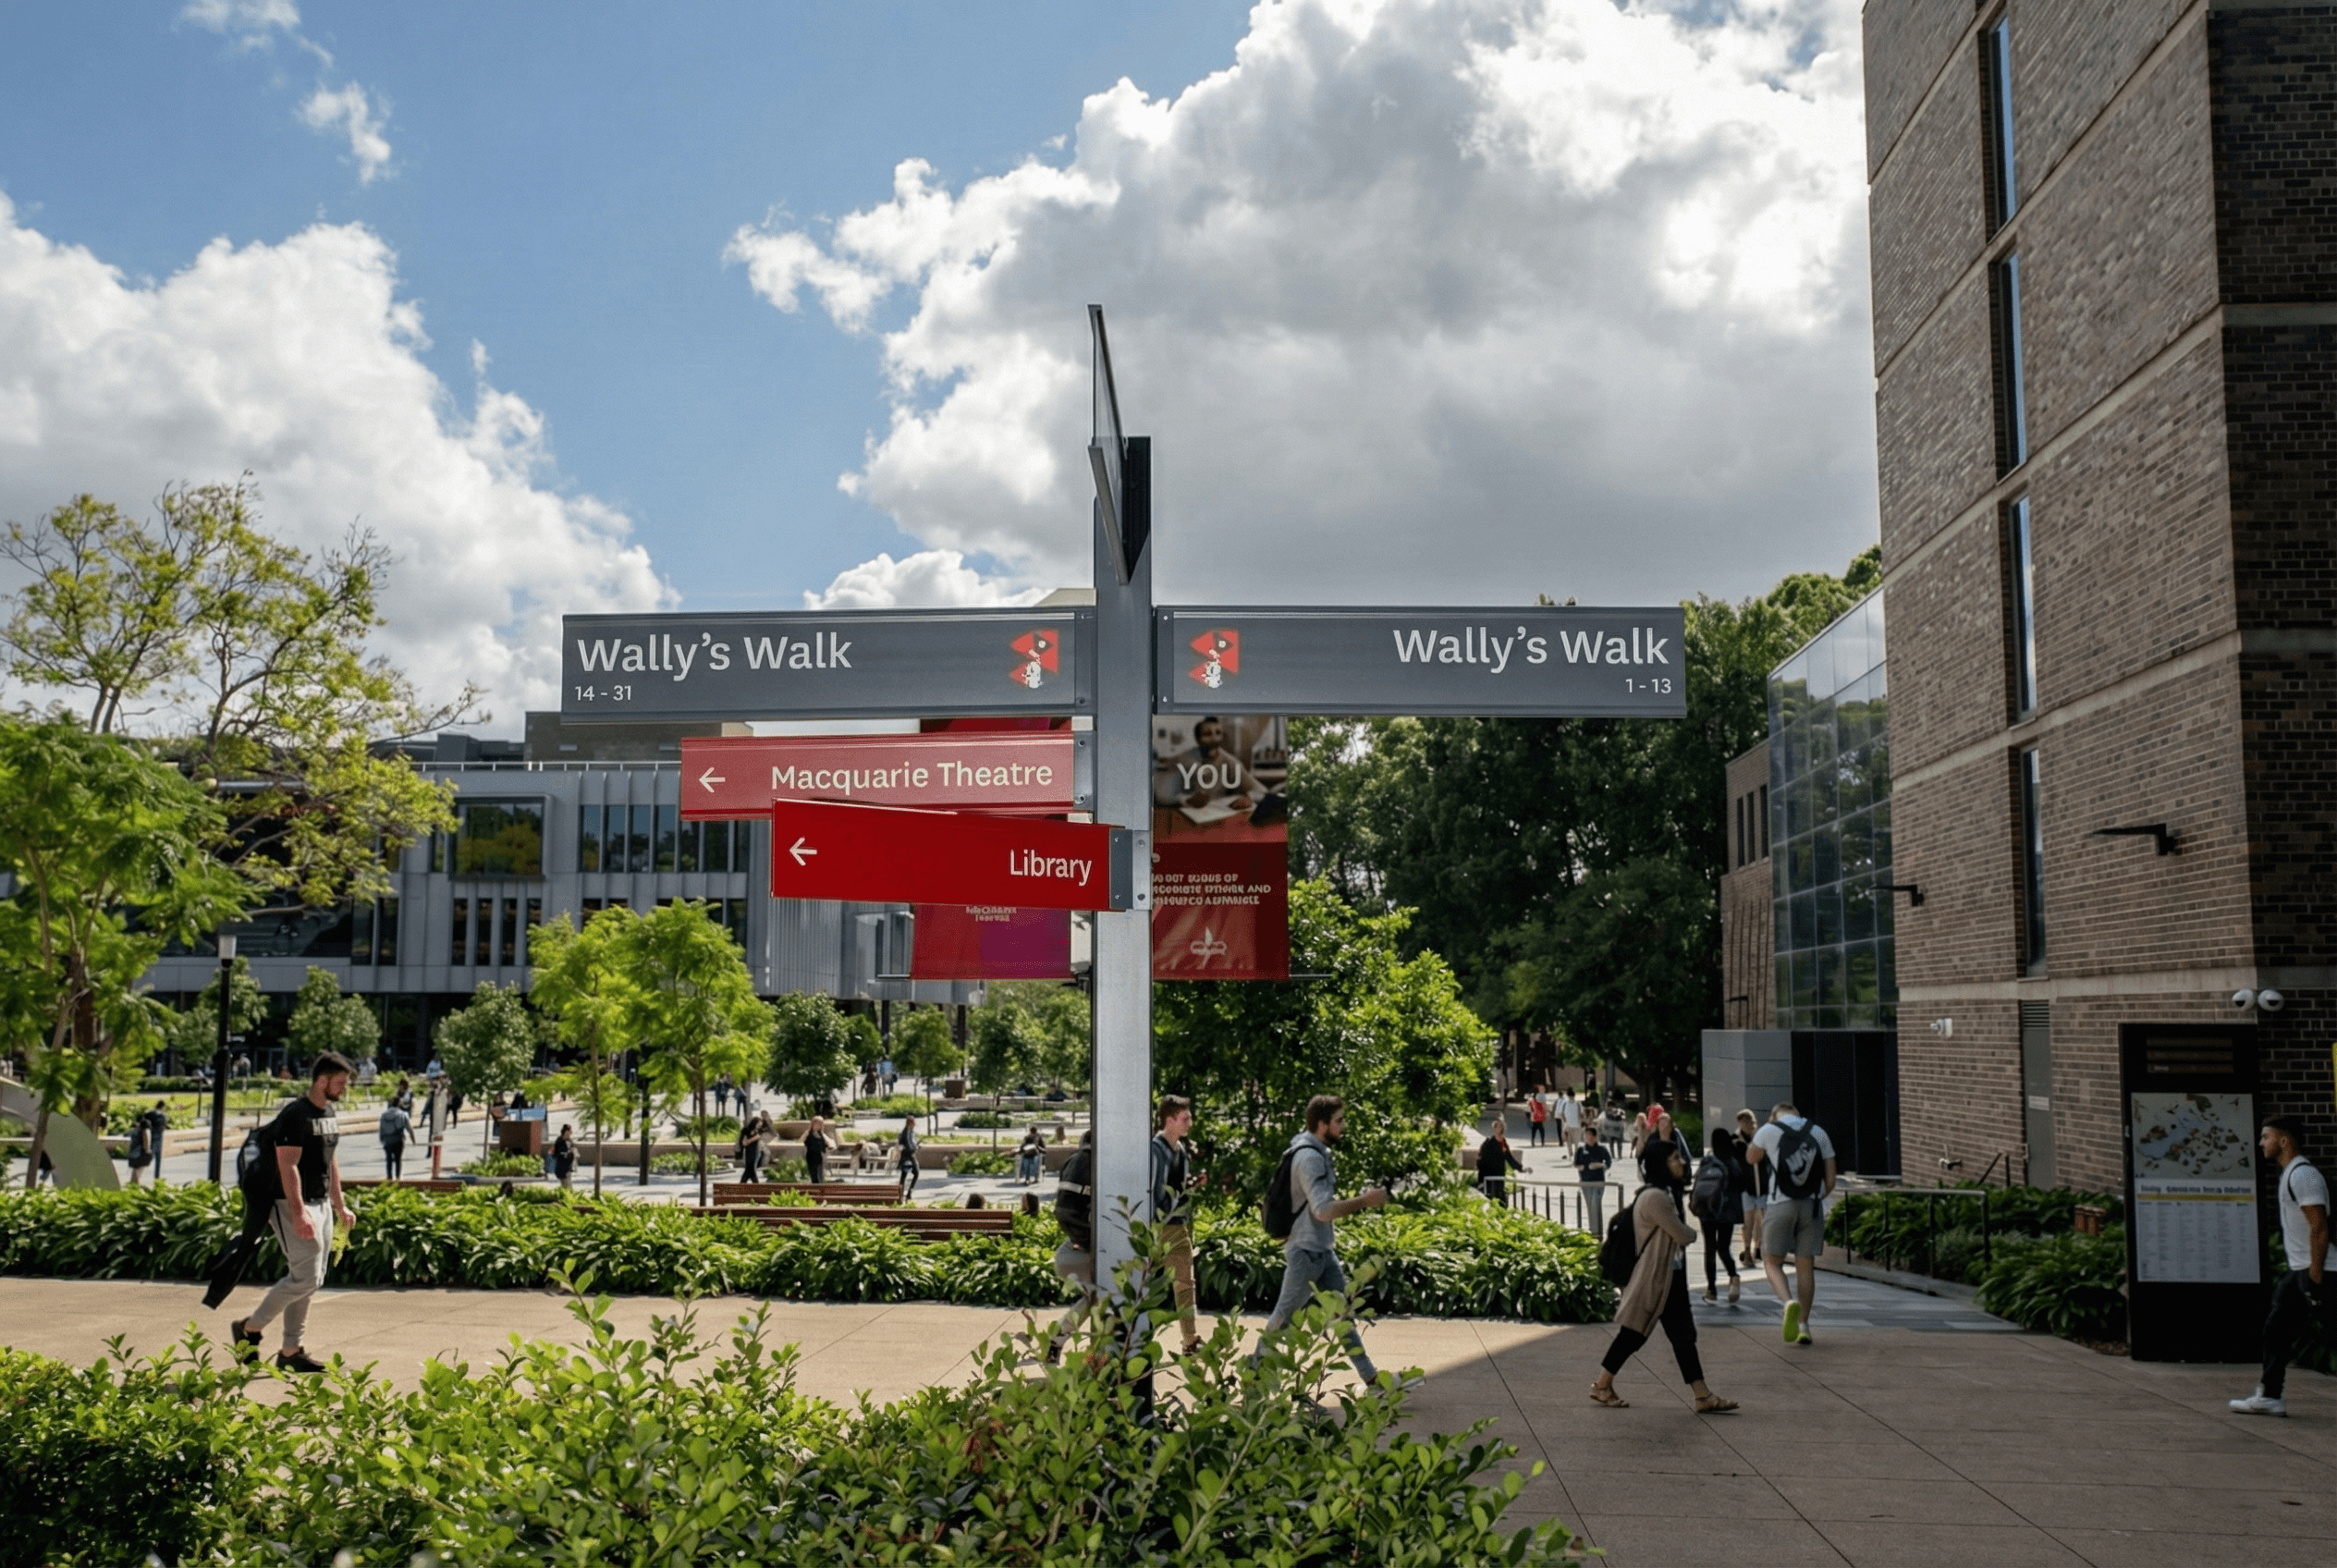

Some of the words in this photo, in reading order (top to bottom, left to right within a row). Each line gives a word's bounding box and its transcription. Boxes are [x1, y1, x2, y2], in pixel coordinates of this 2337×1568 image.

[577, 631, 730, 681] Wally’s
[743, 631, 852, 669] Walk
[1393, 626, 1548, 674] Wally’s
[1560, 627, 1670, 665] Walk
[771, 762, 929, 796] Macquarie
[936, 760, 1053, 787] Theatre
[1177, 763, 1242, 790] YOU
[1009, 849, 1093, 887] Library
[1247, 884, 1272, 893] AND
